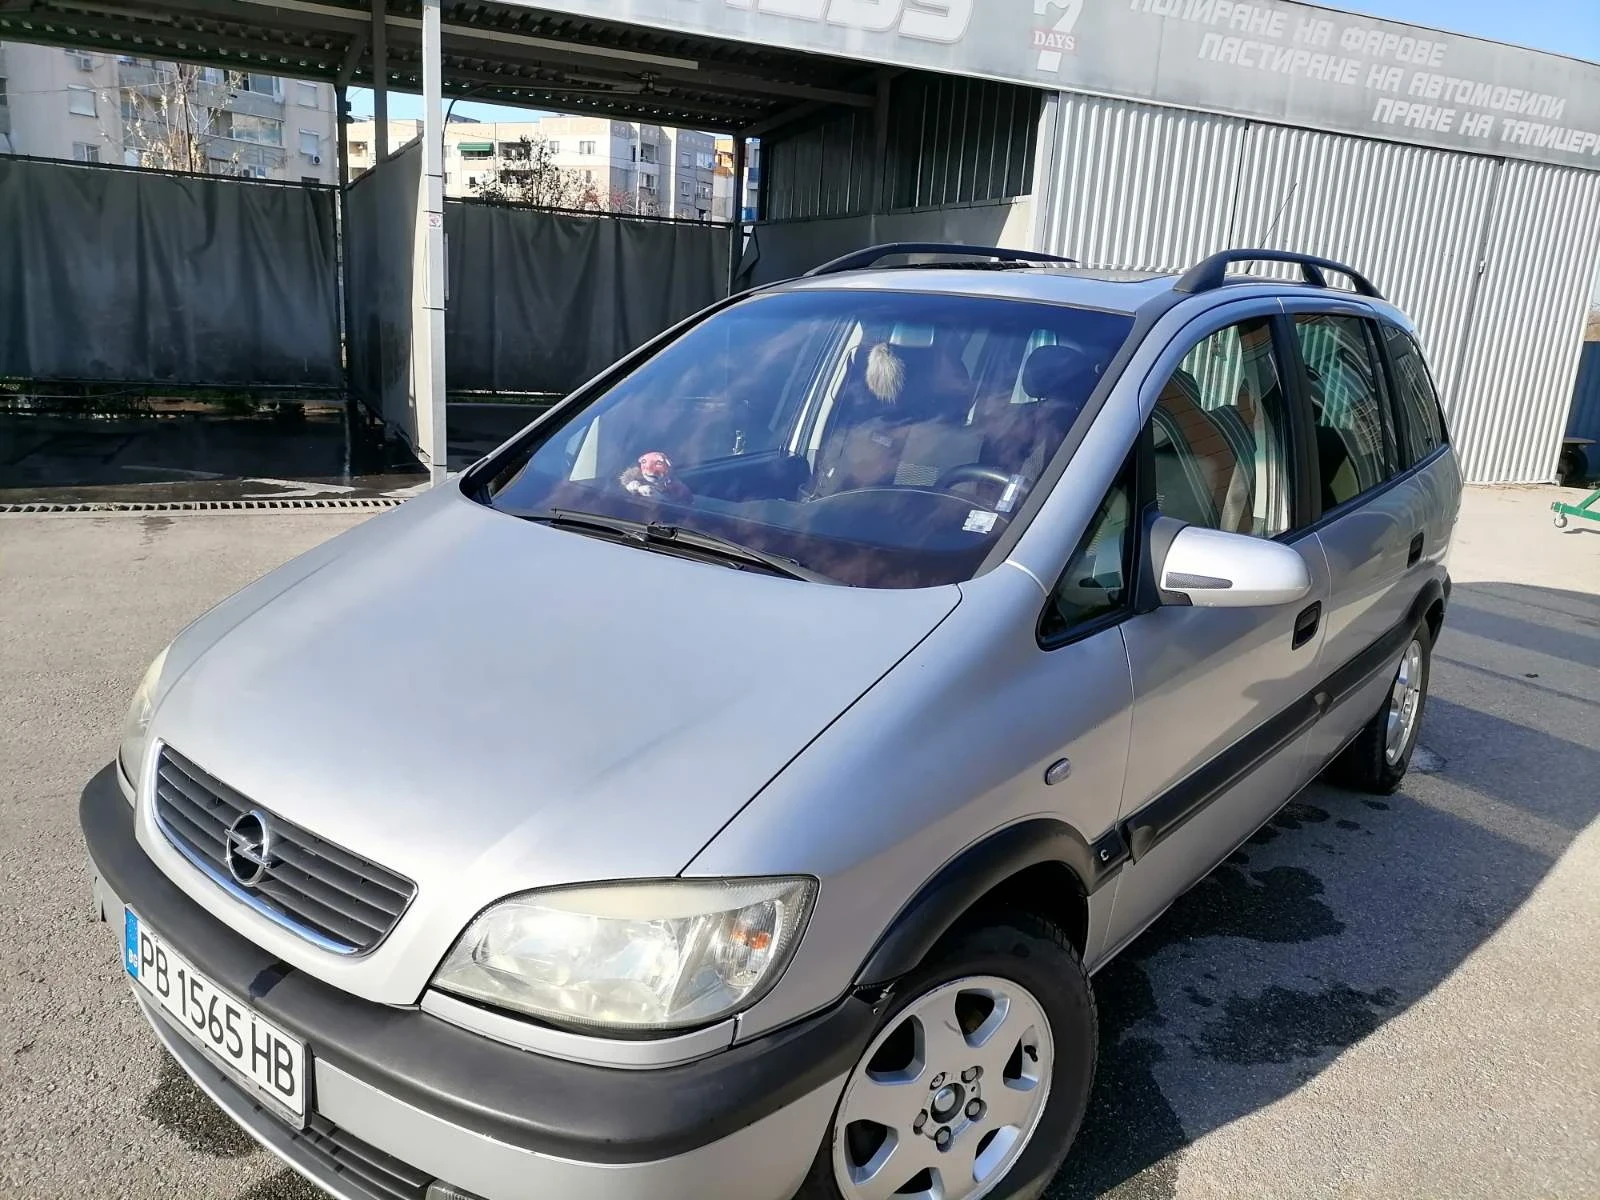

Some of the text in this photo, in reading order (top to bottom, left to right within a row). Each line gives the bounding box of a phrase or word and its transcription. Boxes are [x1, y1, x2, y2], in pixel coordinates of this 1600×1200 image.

[1033, 30, 1075, 50] DAYS
[1293, 17, 1335, 47] НА
[1341, 26, 1448, 68] ФАРОВЕ
[1198, 32, 1567, 120] ПАСТИРАНЕ НА АВТОМОБИЛИ
[1372, 98, 1456, 132] ПРАНЕ
[1458, 111, 1495, 138] НА
[128, 948, 138, 968] BG
[140, 931, 295, 1097] PB 1565 HB
